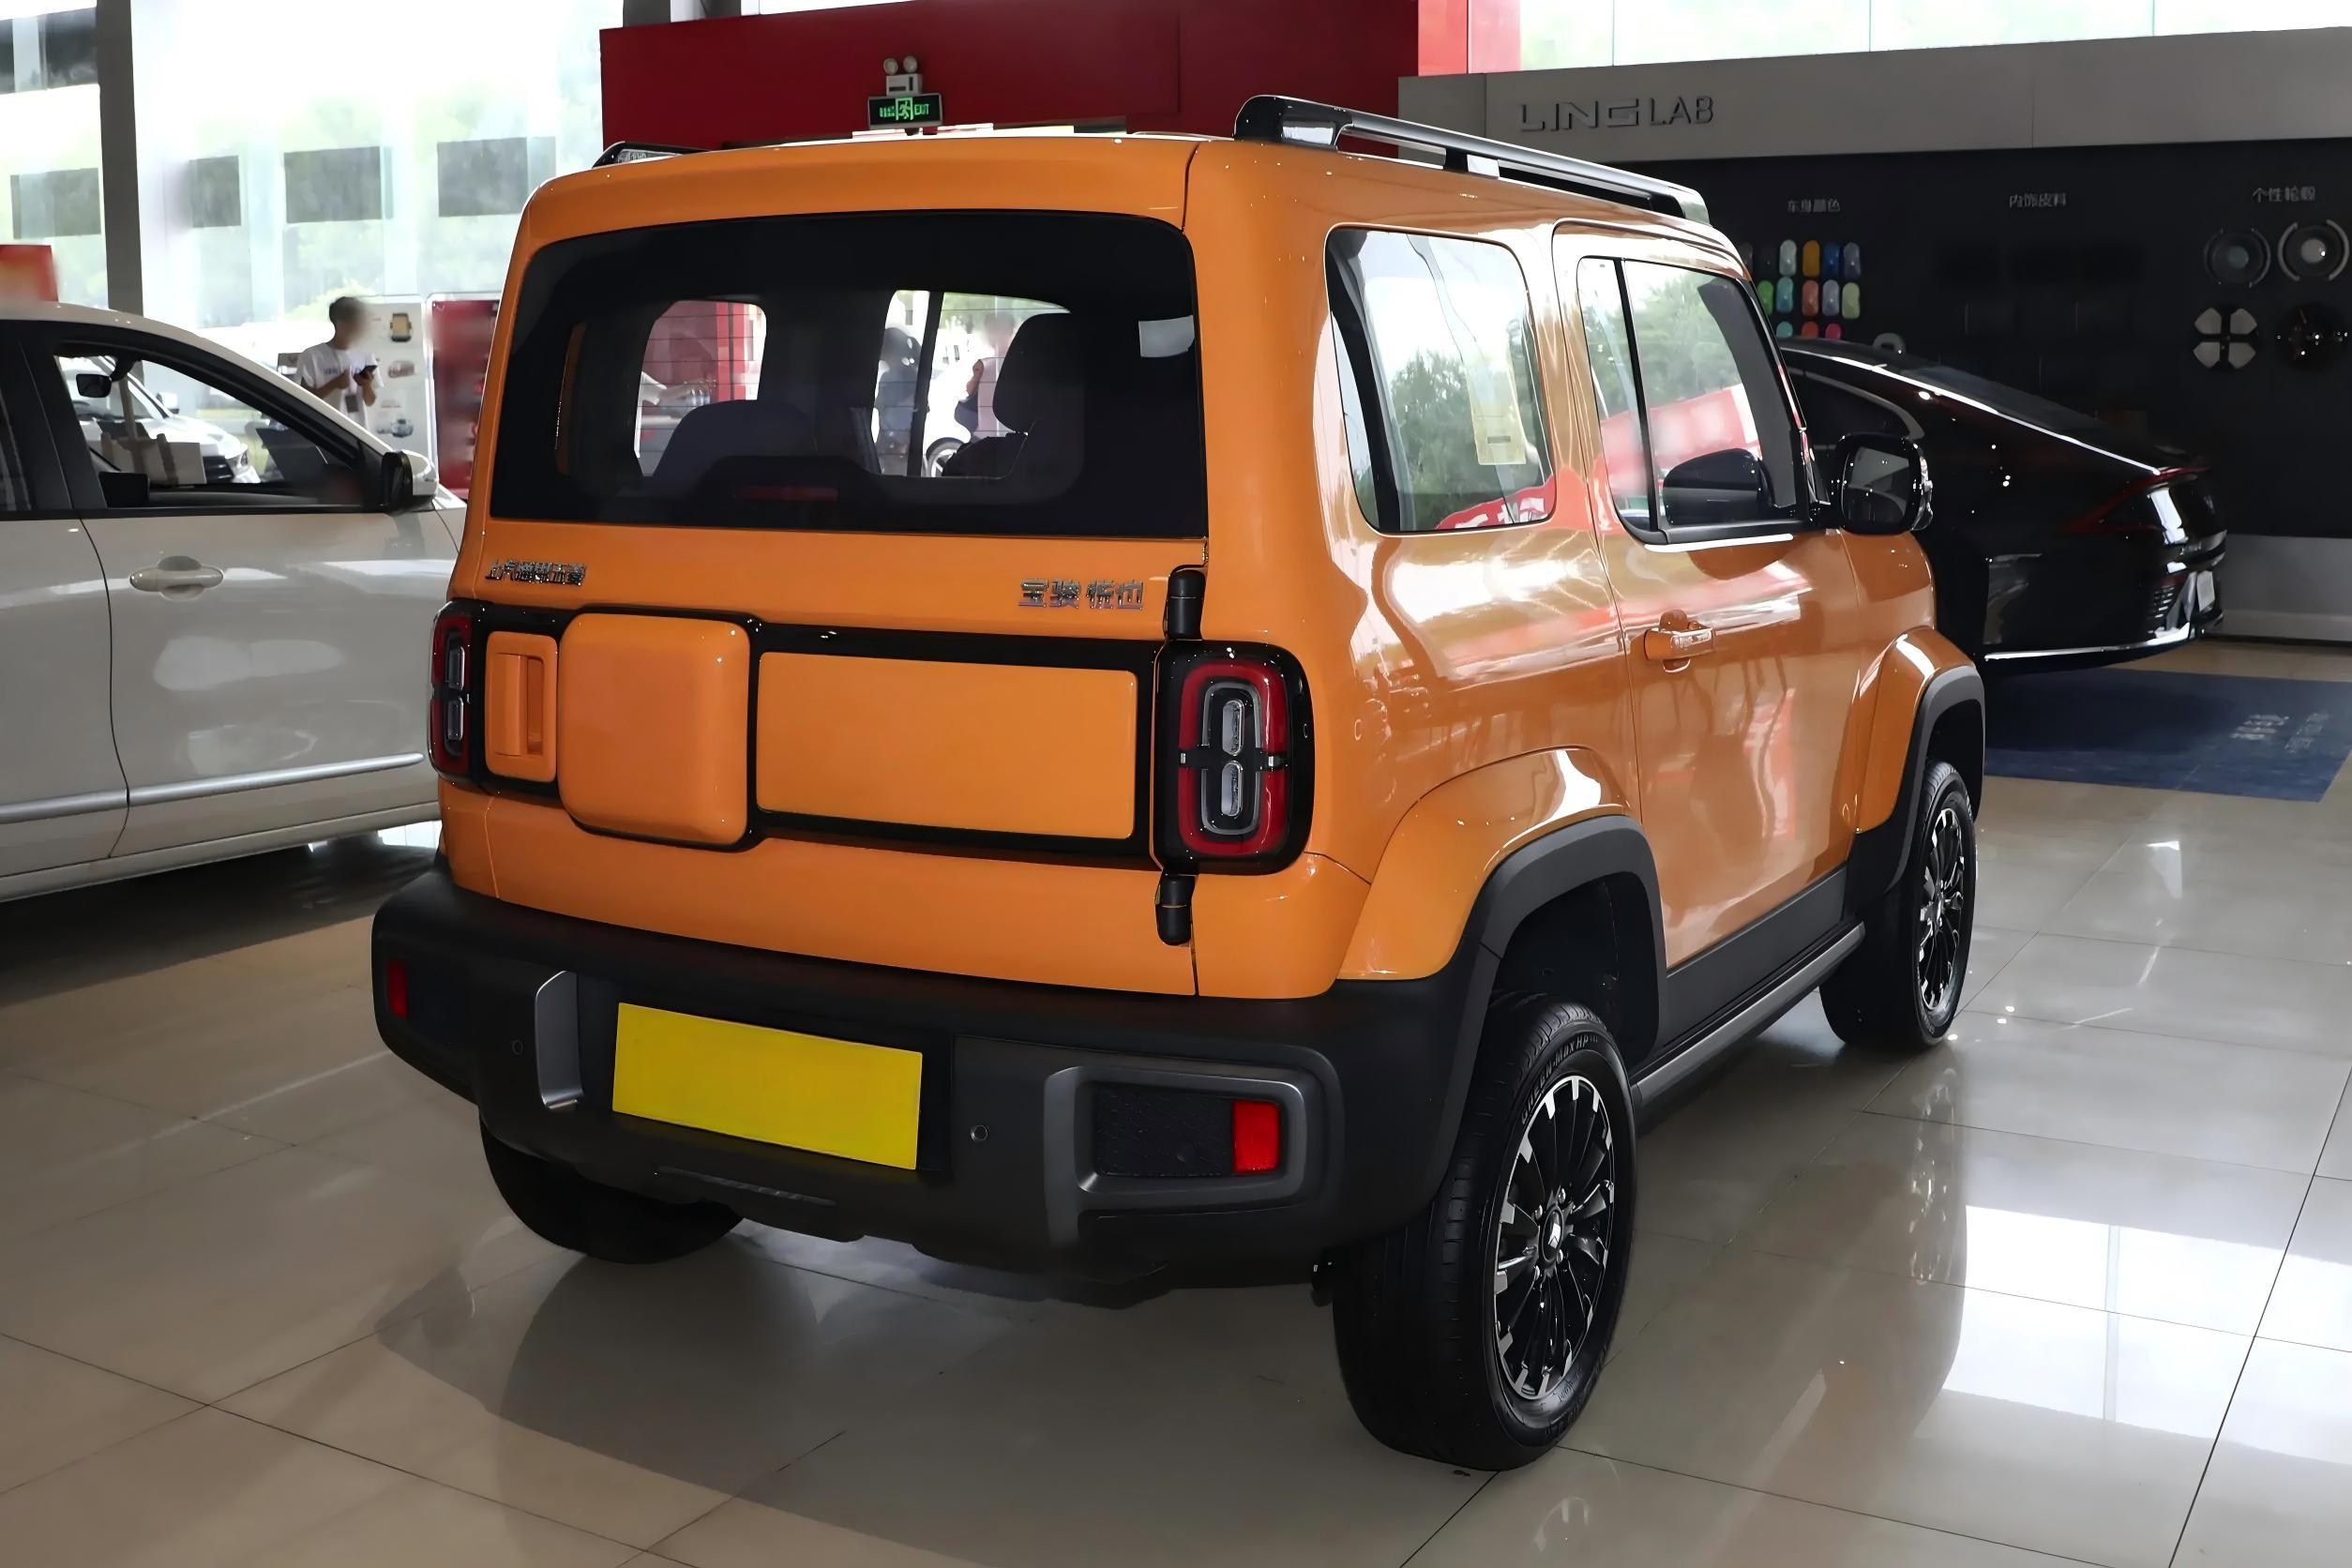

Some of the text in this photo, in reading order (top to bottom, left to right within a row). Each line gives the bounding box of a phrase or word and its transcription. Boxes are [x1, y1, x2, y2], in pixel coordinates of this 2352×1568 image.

[1520, 95, 1714, 132] LING LAB
[1576, 1034, 1590, 1049] HP
